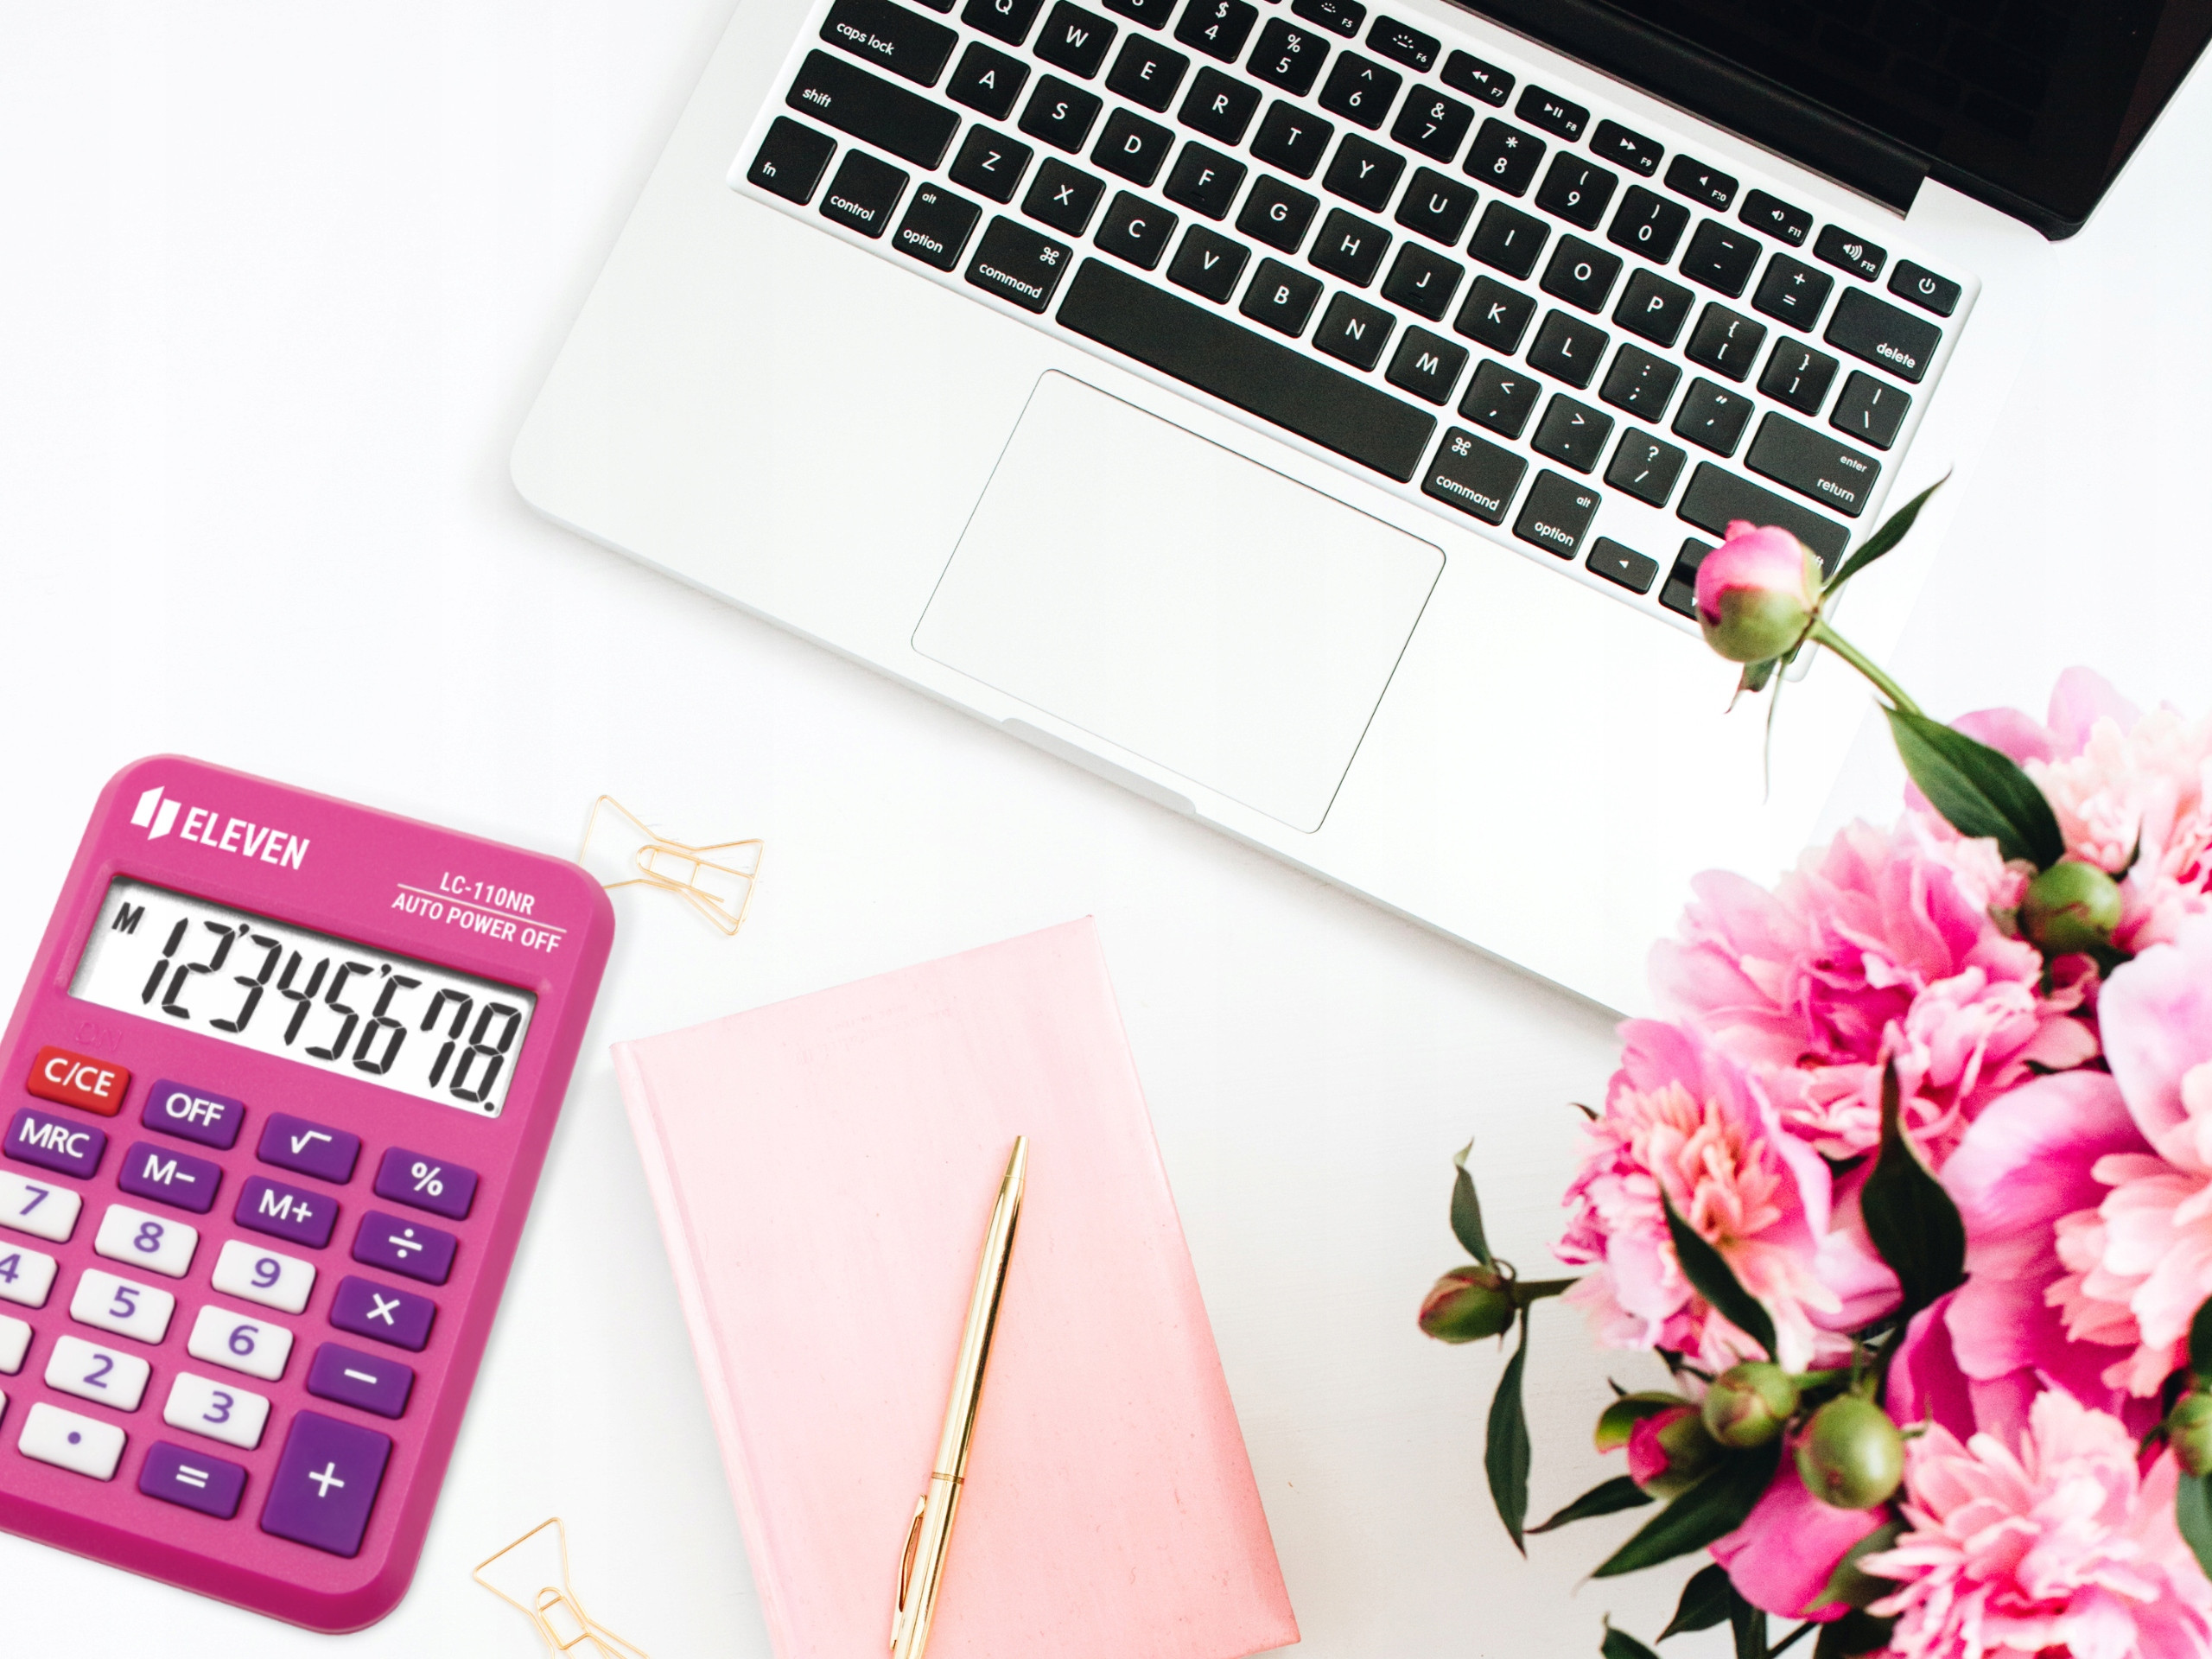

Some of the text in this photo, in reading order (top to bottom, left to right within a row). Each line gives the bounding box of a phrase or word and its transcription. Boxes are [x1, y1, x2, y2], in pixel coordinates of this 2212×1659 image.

[995, 0, 1013, 16] Q
[1215, 1, 1230, 18] $
[1205, 24, 1219, 40] 4
[1341, 17, 1353, 28] F5
[836, 22, 894, 55] caps lock
[1066, 25, 1089, 48] W
[1287, 34, 1301, 53] %
[1275, 57, 1292, 73] 5
[1416, 52, 1427, 63] F6
[978, 70, 995, 89] A
[1140, 60, 1157, 80] E
[802, 88, 831, 108] shift
[1349, 91, 1363, 106] 6
[1491, 87, 1503, 97] F7
[1052, 102, 1069, 120] S
[1211, 94, 1229, 114] R
[1430, 102, 1445, 120] &
[1287, 127, 1302, 145] T
[1421, 123, 1437, 139] 7
[1566, 121, 1577, 131] F8
[1123, 134, 1142, 154] D
[762, 162, 777, 177] fn
[982, 150, 1001, 172] Z
[1359, 160, 1375, 179] Y
[1493, 157, 1508, 174] 8
[1640, 156, 1652, 167] F9
[1198, 168, 1215, 186] F
[922, 193, 937, 205] alt
[1053, 184, 1074, 206] X
[1428, 194, 1448, 213] U
[1567, 191, 1580, 207] 9
[830, 195, 875, 222] control
[1269, 203, 1288, 221] G
[1128, 219, 1146, 238] C
[902, 229, 944, 254] option
[1340, 234, 1361, 256] H
[1204, 251, 1220, 270] V
[1860, 260, 1876, 273] F12
[978, 264, 1043, 300] command
[1416, 271, 1432, 288] J
[1273, 285, 1290, 304] B
[1647, 296, 1664, 313] P
[1487, 302, 1507, 324] K
[1345, 318, 1366, 340] N
[1561, 337, 1573, 358] L
[1876, 342, 1916, 369] delete
[1415, 352, 1439, 375] M
[1647, 445, 1660, 461] ?
[1840, 453, 1868, 474] enter
[1435, 474, 1501, 512] command
[1816, 477, 1856, 503] return
[1576, 496, 1592, 508] alt
[1534, 521, 1574, 547] option
[179, 804, 310, 870] ELEVEN
[437, 871, 536, 917] LC-110NR
[391, 892, 562, 954] AUTO POWER OFF
[44, 1058, 115, 1097] C/CE
[165, 1092, 225, 1127] OFF
[19, 1117, 90, 1158] MRC
[411, 1162, 443, 1197] %
[19, 1183, 51, 1216] 7
[258, 1188, 313, 1223] M+
[133, 1221, 164, 1254] 8
[0, 1253, 21, 1284] 4
[251, 1257, 282, 1288] 9
[109, 1285, 140, 1319] 5
[228, 1324, 259, 1357] 6
[83, 1353, 114, 1389] 2
[202, 1390, 234, 1424] 3
